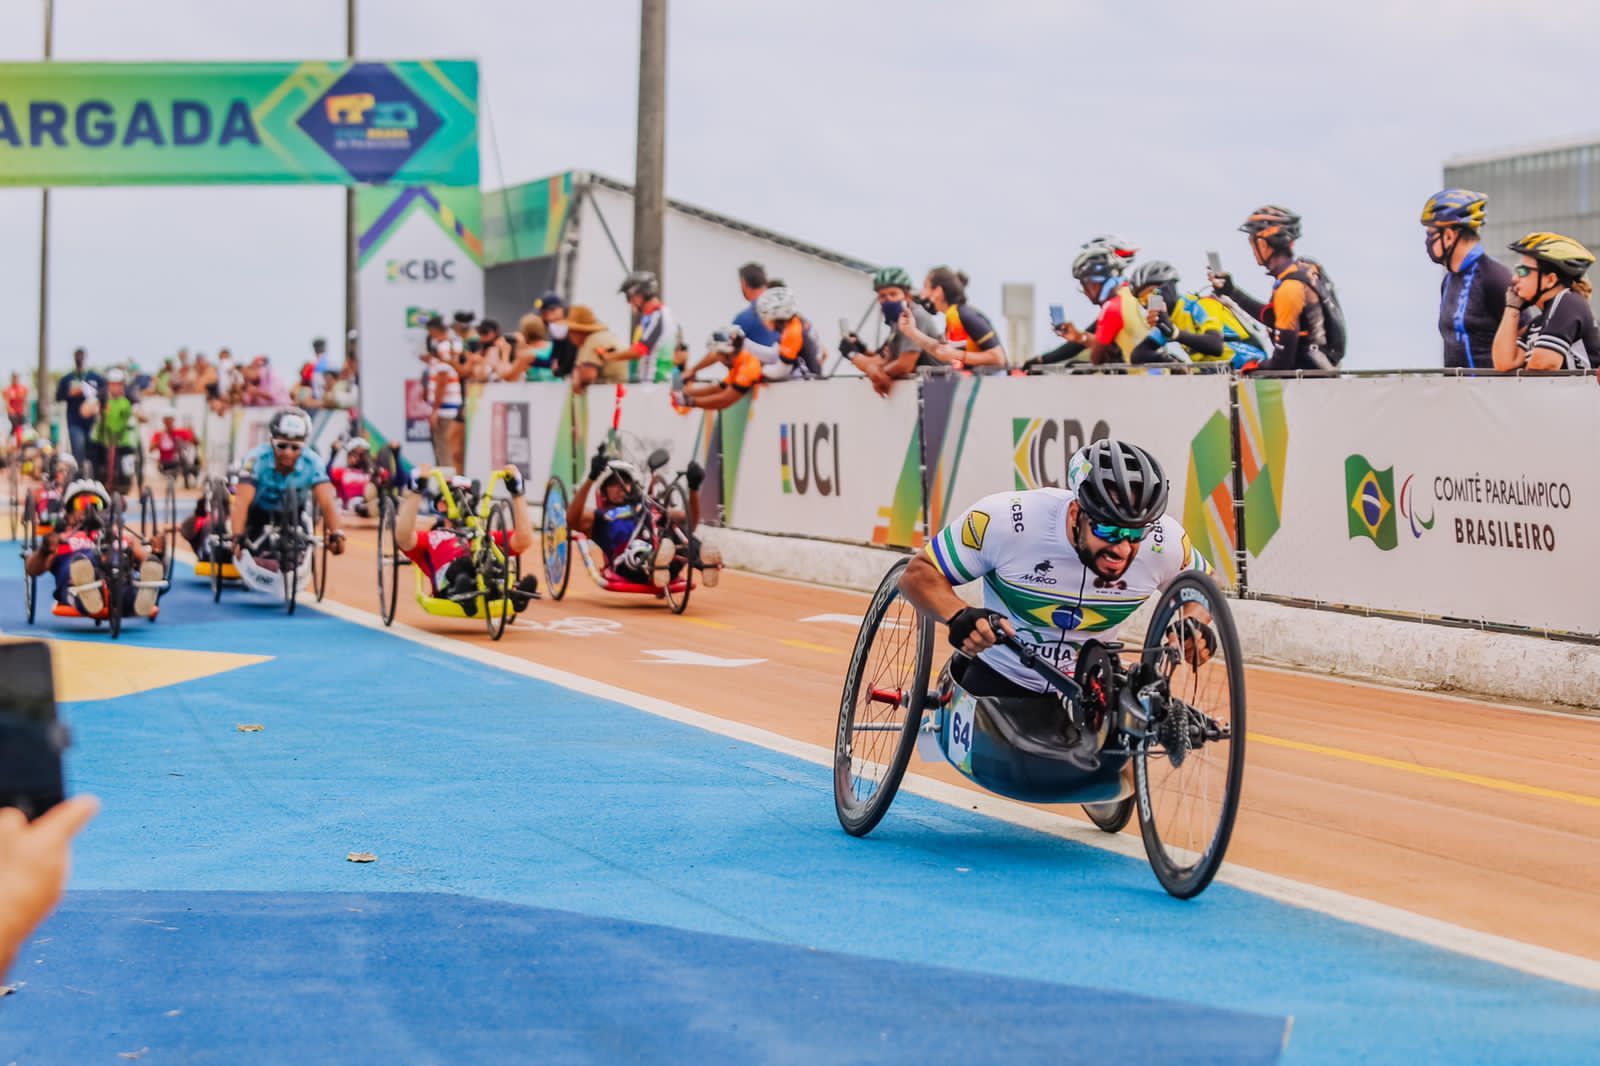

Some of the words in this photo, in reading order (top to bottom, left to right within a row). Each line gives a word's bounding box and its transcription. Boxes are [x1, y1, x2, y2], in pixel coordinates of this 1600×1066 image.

[0, 99, 262, 147] ARGADA
[406, 259, 457, 281] CBC
[791, 422, 841, 497] UCI
[1038, 418, 1110, 490] CB
[1485, 474, 1571, 509] PARALÍMPICO
[1012, 503, 1025, 533] CBC
[1454, 517, 1556, 552] BRASILEIRO
[953, 711, 970, 753] 64
